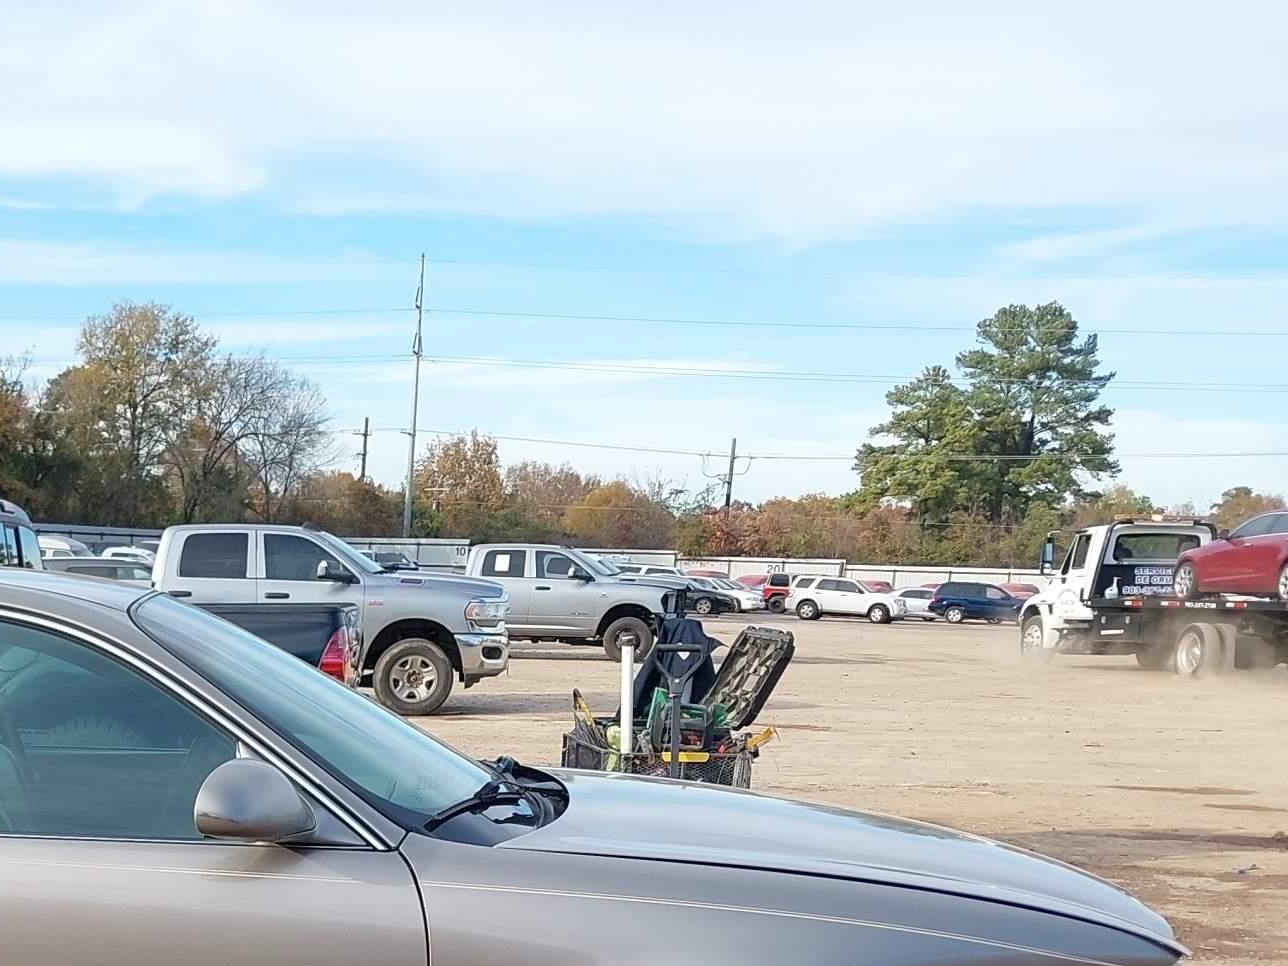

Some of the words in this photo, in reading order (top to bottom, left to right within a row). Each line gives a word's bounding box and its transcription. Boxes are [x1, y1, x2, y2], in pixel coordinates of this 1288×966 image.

[456, 547, 466, 556] 10
[766, 565, 781, 573] 20
[1135, 576, 1150, 584] DE
